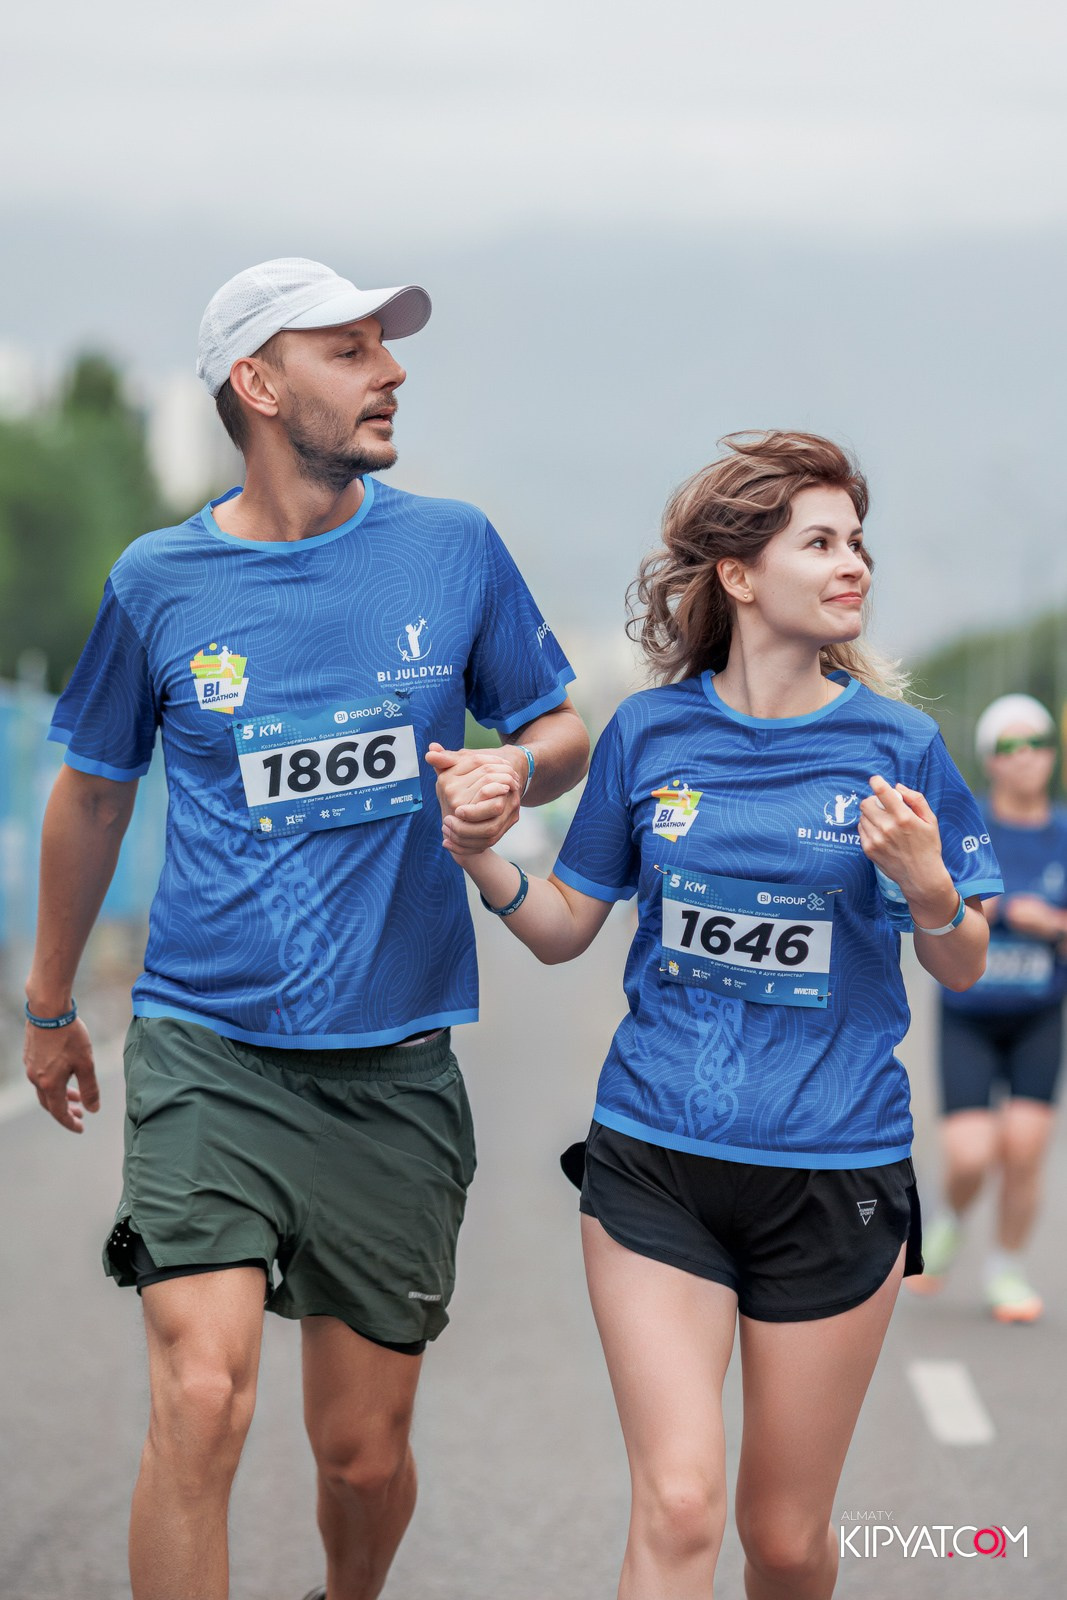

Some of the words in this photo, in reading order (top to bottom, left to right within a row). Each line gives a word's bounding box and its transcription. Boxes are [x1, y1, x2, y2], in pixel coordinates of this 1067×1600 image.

[377, 670, 391, 682] BI
[394, 664, 453, 680] JULDYZAI
[203, 680, 220, 698] BI
[202, 692, 239, 704] MARATHON
[349, 706, 382, 719] GROUP
[242, 724, 254, 740] 5
[259, 722, 282, 738] KM
[262, 735, 396, 798] 1866
[657, 809, 674, 821] BI
[798, 828, 812, 838] BI
[815, 830, 861, 845] JULDYZ
[964, 838, 976, 851] BI
[669, 874, 682, 888] 5
[684, 881, 707, 894] KM
[773, 896, 806, 905] GROUP
[680, 910, 814, 966] 1646
[794, 987, 818, 995] INVICTUS
